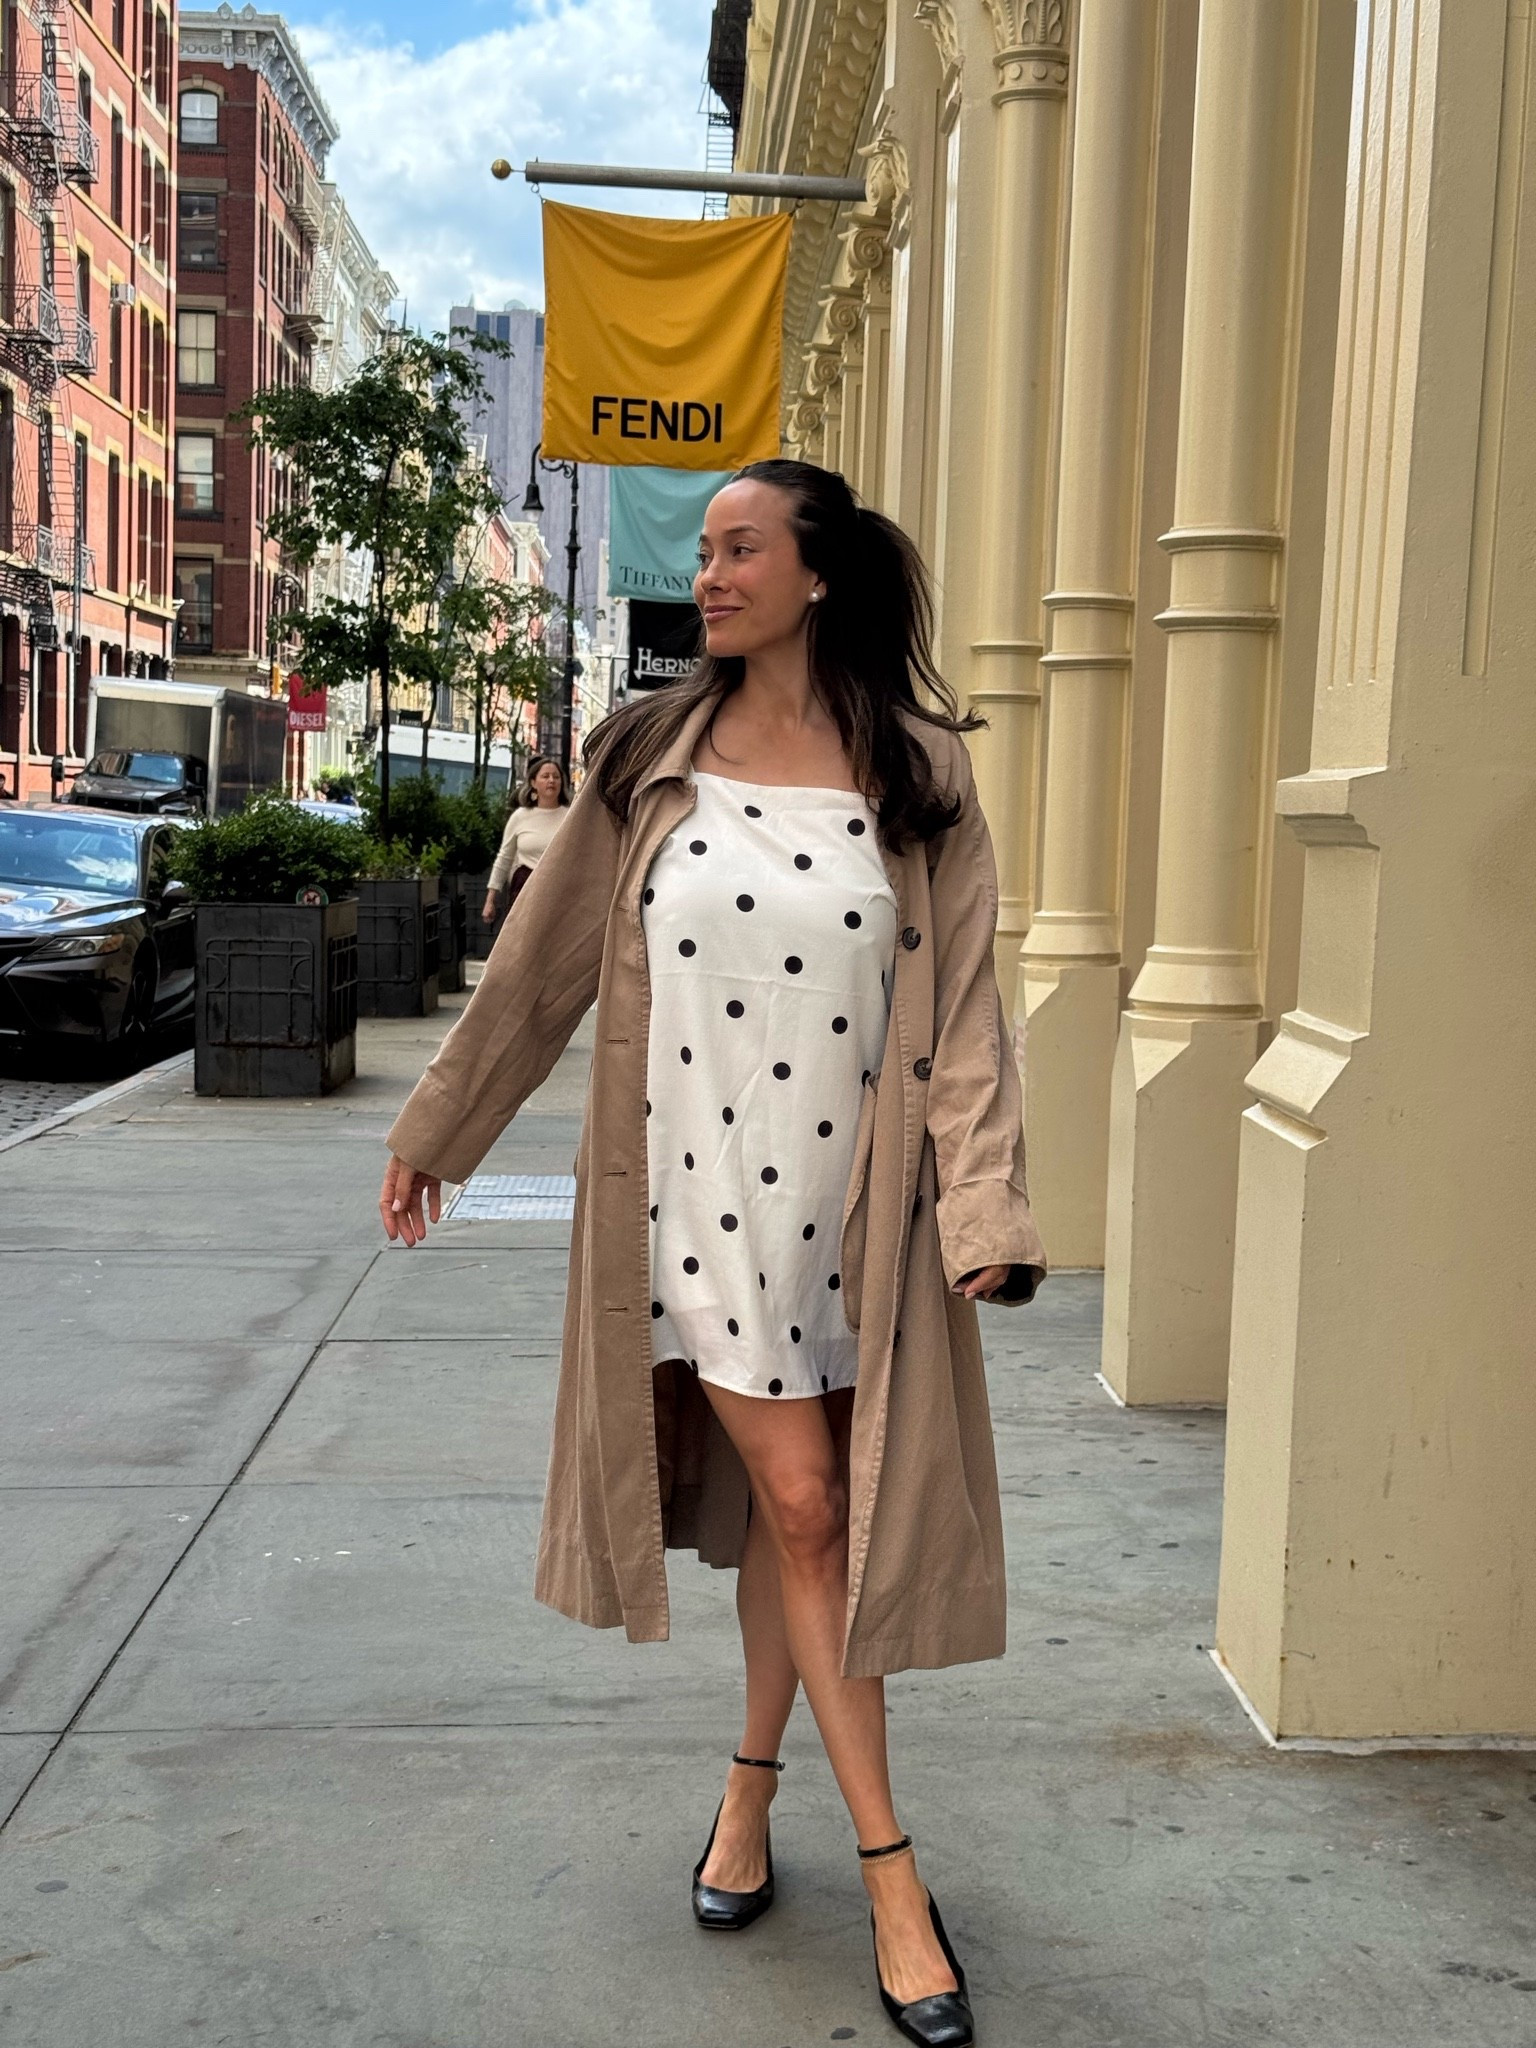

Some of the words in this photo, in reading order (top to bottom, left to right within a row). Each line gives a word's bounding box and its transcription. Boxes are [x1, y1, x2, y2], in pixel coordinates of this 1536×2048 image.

[592, 396, 722, 443] FENDI
[620, 566, 694, 590] TIFFANY
[289, 711, 324, 727] DIESEL
